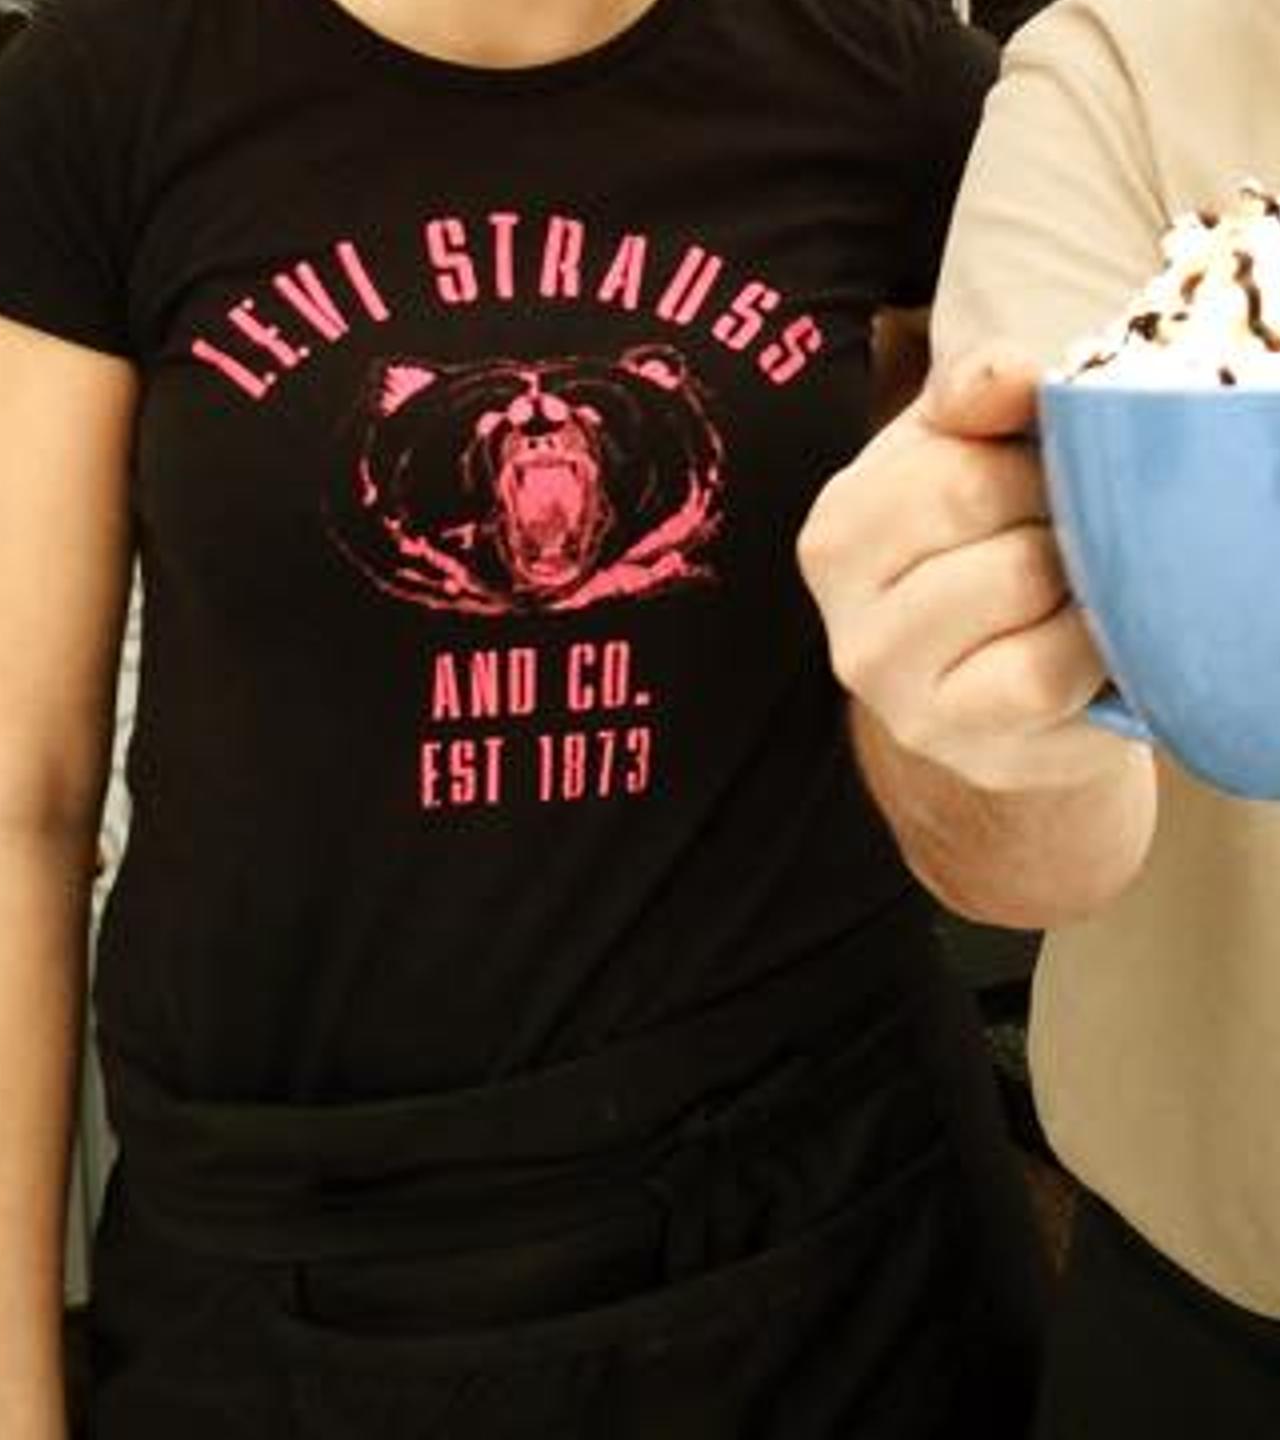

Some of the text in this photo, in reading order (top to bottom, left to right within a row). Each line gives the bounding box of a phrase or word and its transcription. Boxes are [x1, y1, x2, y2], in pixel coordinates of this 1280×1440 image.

[192, 213, 822, 399] LEVI STRAUSS
[432, 641, 651, 720] AND CO.
[422, 726, 651, 808] EST 1873
